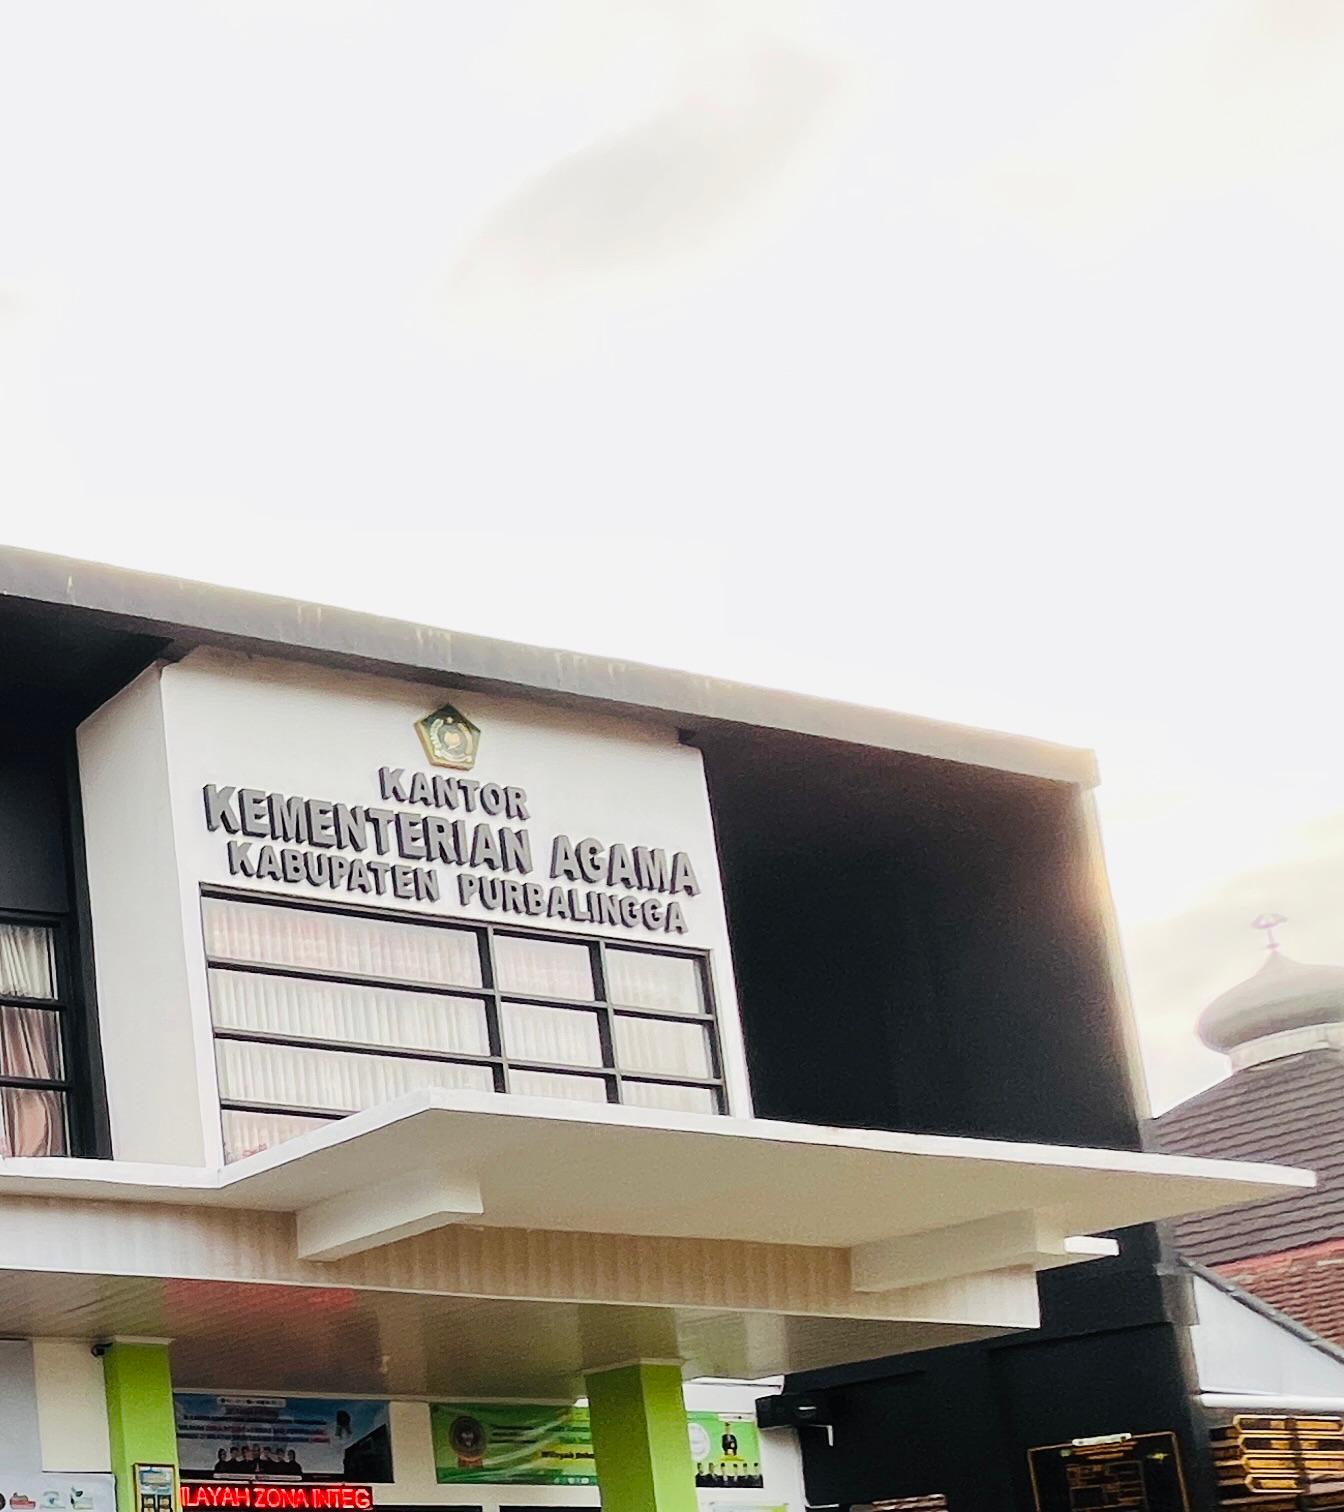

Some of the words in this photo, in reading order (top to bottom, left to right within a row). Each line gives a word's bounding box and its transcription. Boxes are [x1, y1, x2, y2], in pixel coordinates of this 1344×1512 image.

[379, 766, 529, 820] KANTOR
[203, 784, 532, 876] KEMENTERIAN
[550, 834, 701, 898] AGAMA
[227, 840, 440, 903] KABUPATEN
[457, 873, 688, 935] PURBALINGGA
[180, 1486, 251, 1507] ILAYAH
[253, 1487, 310, 1508] ZONA
[311, 1488, 372, 1510] INTEG
